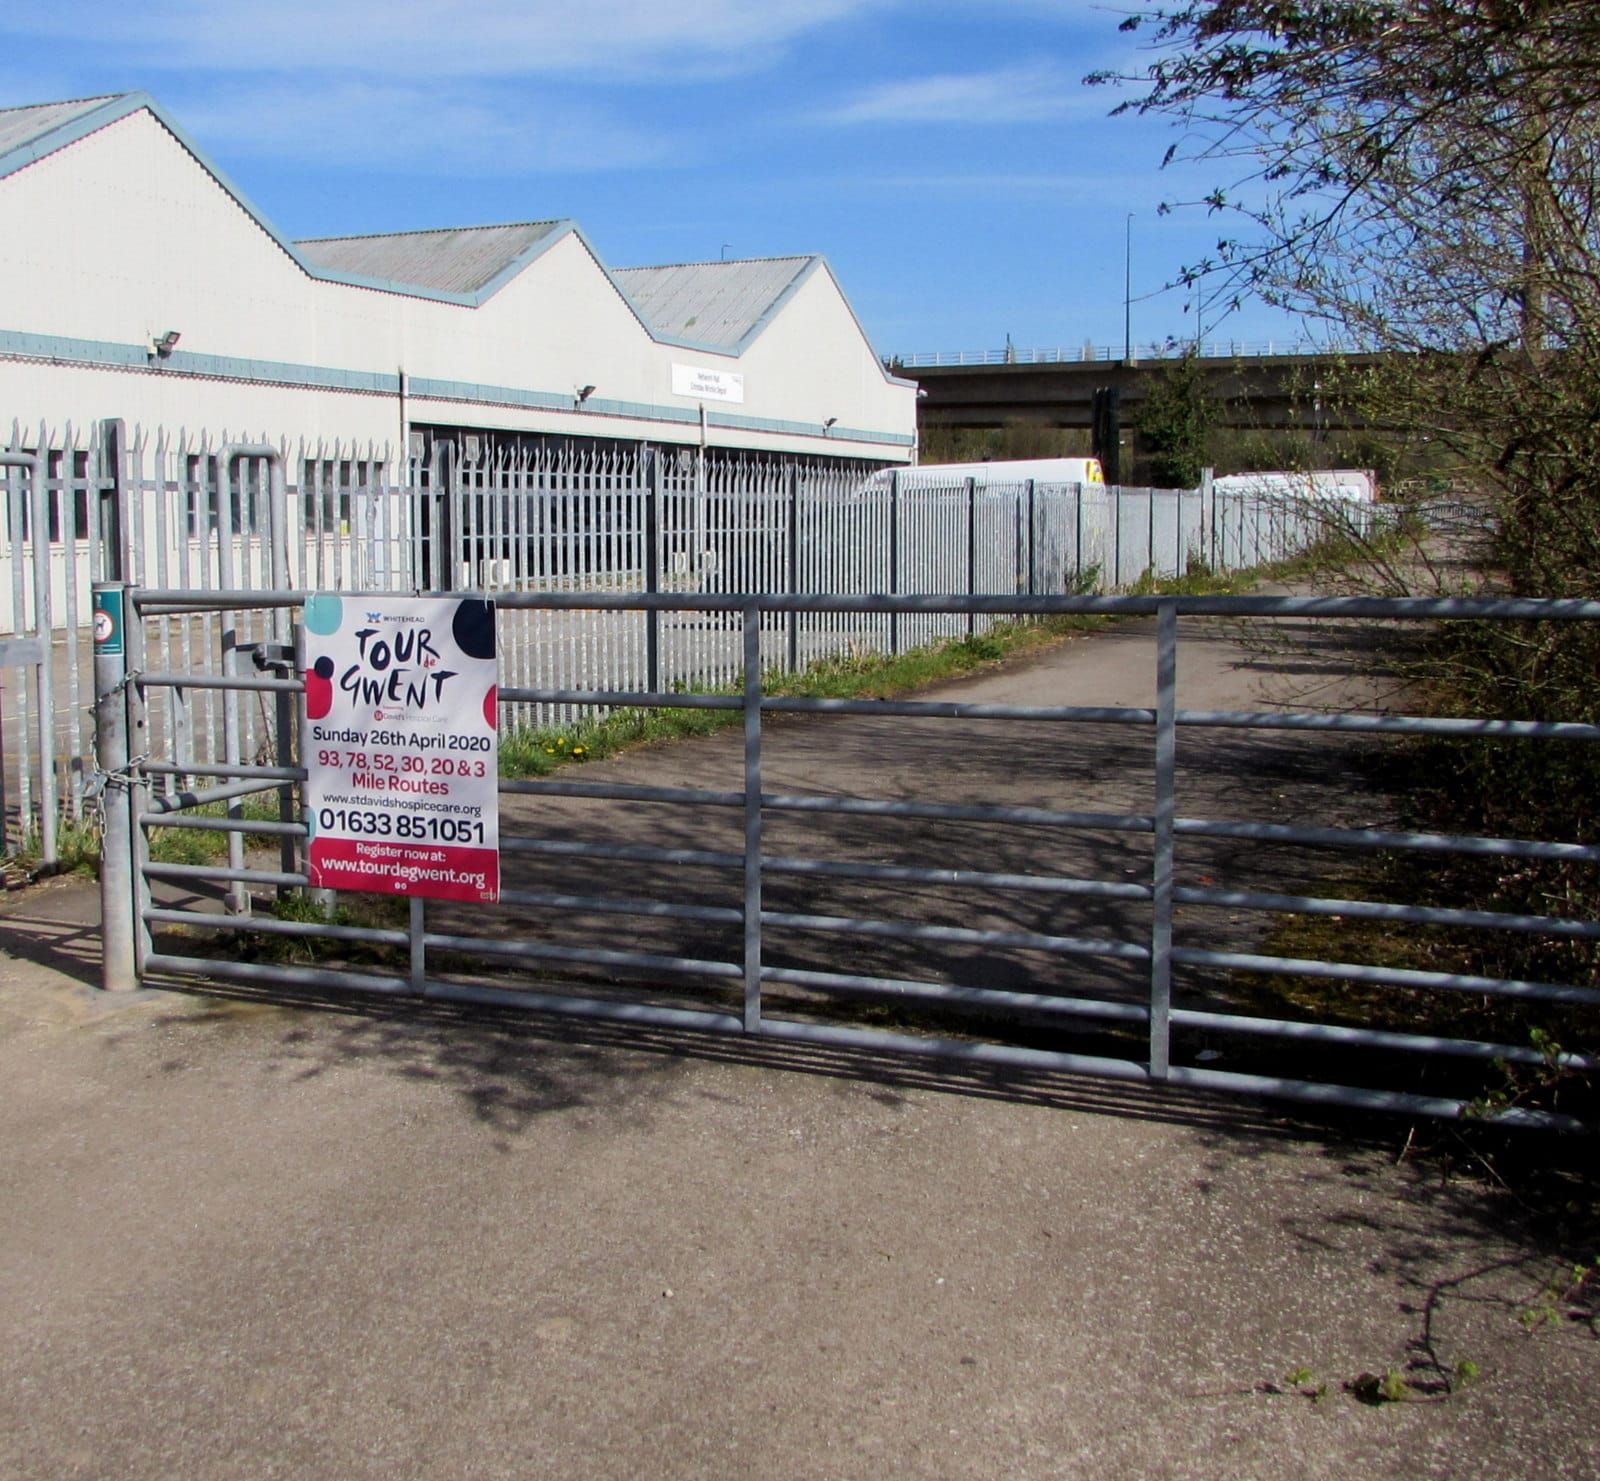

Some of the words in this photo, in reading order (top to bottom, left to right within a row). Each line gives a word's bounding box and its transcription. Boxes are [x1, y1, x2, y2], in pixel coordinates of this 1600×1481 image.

[354, 628, 440, 670] TOUR
[423, 654, 436, 669] de
[339, 664, 459, 709] GWENT
[313, 726, 368, 746] Sunday
[370, 730, 406, 746] 26th
[409, 733, 446, 750] April
[449, 735, 491, 751] 2020
[318, 750, 343, 769] 93,
[346, 752, 371, 771] 78,
[373, 754, 399, 773] 52,
[401, 756, 428, 775] 30,
[431, 758, 454, 775] 20
[457, 761, 472, 776] &
[474, 761, 486, 777] 3
[352, 772, 385, 790] Mile
[388, 775, 449, 795] Routes
[323, 794, 481, 817] www.stdavidshospicecare.org
[320, 808, 392, 835] 01633
[396, 815, 484, 844] 851051
[356, 842, 403, 859] Register
[404, 850, 430, 861] now
[430, 852, 446, 862] at:
[321, 857, 486, 889] www.tourdegwent.org
